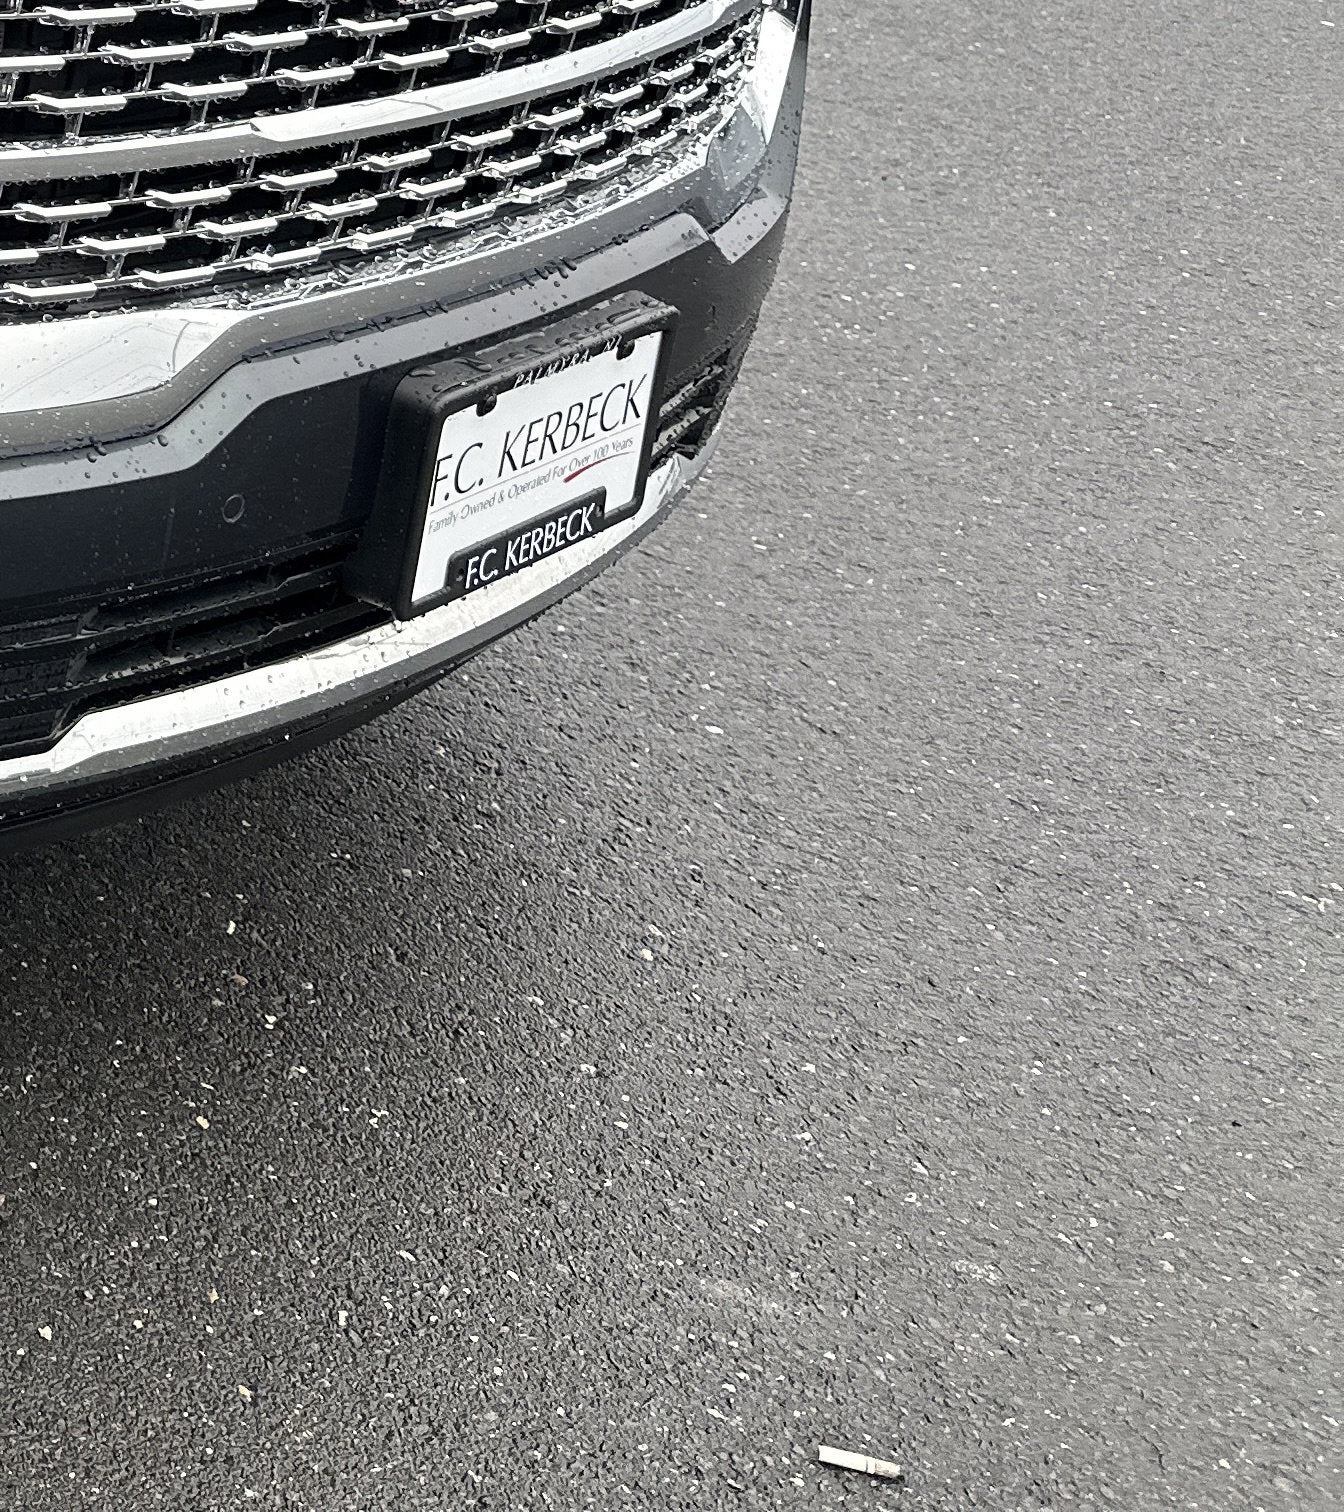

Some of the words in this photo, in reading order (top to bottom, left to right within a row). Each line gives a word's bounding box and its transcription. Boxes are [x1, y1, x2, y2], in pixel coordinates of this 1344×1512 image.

[428, 510, 459, 535] Family
[461, 496, 496, 520] Owned
[498, 491, 505, 504] &
[507, 471, 552, 500] Operated
[552, 463, 568, 481] For
[569, 454, 590, 473] Over
[592, 444, 610, 463] 100
[612, 437, 634, 454] Years
[430, 442, 484, 507] F.C.
[497, 373, 648, 478] KERBECK
[465, 548, 499, 589] F.C.
[505, 502, 596, 571] KERBECK
